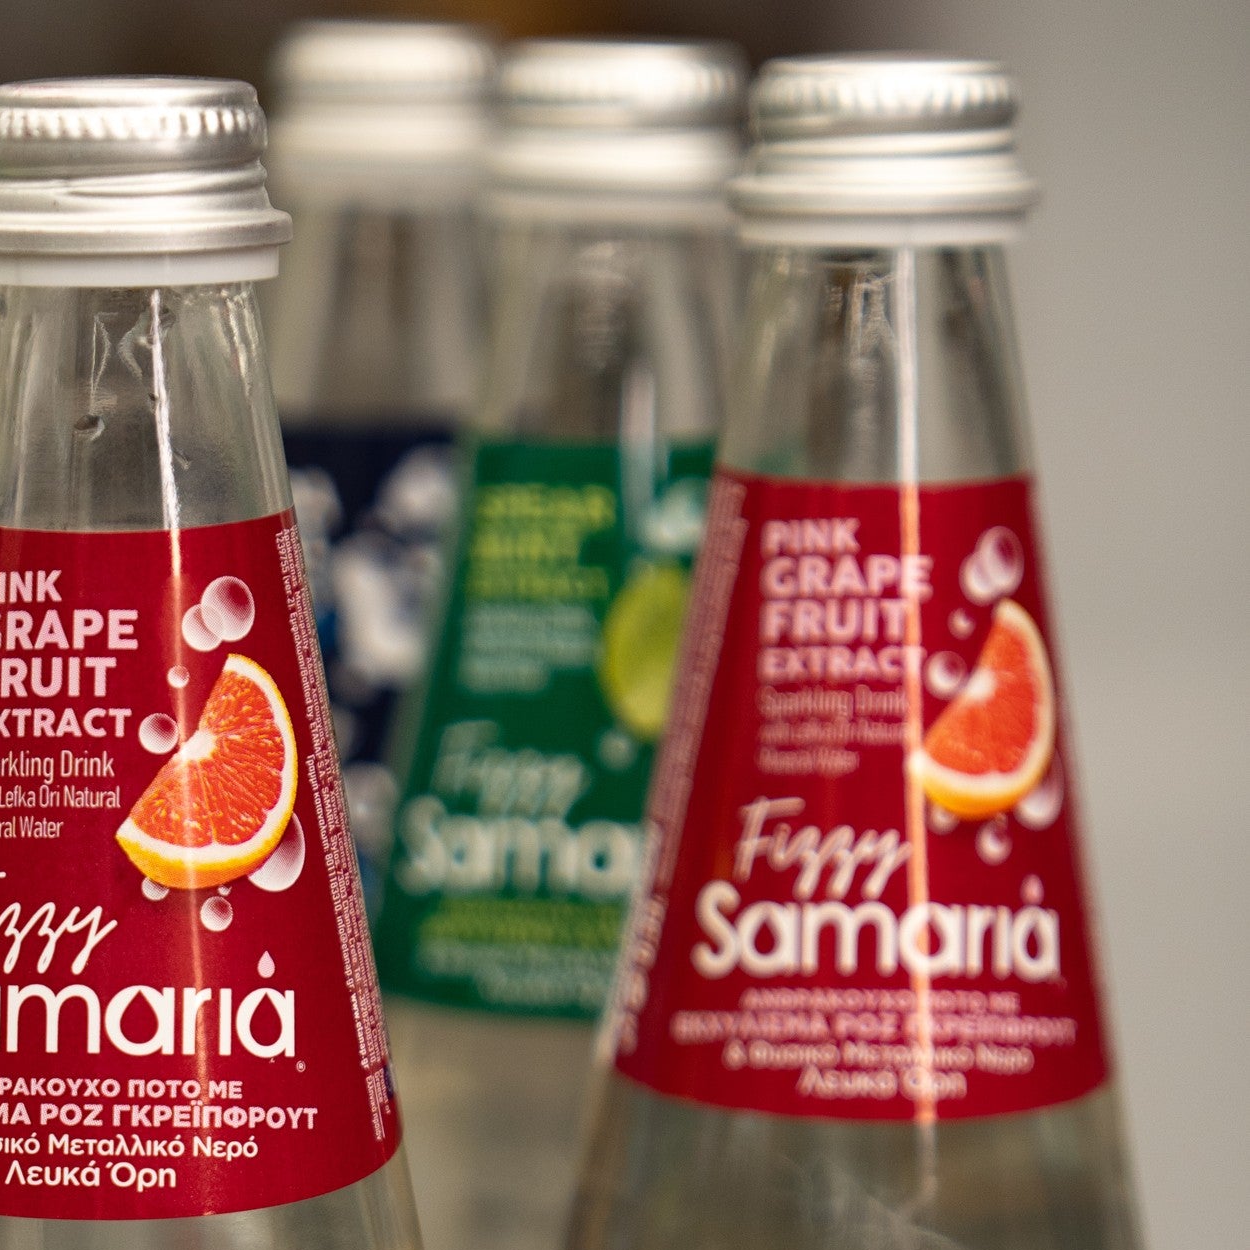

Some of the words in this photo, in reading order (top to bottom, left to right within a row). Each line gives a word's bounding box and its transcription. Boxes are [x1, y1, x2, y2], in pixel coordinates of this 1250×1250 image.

[760, 518, 859, 553] PINK
[760, 555, 933, 597] GRAPE
[759, 599, 920, 643] FRUIT
[758, 646, 926, 682] EXTRACT
[274, 530, 290, 573] 1239755
[308, 721, 322, 760] ETANAP
[335, 868, 348, 899] 73003
[60, 750, 115, 777] Drink
[39, 785, 59, 808] Ori
[62, 784, 121, 809] Natural
[18, 818, 63, 839] Water
[734, 796, 914, 899] Fizzy
[304, 753, 321, 791] Γραμμή
[348, 991, 370, 1070] www.etanap.gr
[128, 1078, 202, 1099] ΠΟΤΟ
[208, 1080, 243, 1100] ΜΕ
[373, 1070, 384, 1104] Greece
[39, 1103, 104, 1126] ΡΟΖ
[113, 1101, 318, 1130] ΓΚΡΕΪΠΦΡΟΥΤ
[48, 1133, 185, 1158] Μεταλλικό
[193, 1136, 259, 1160] Νερό
[5, 1159, 101, 1187] Λευκά
[104, 1159, 177, 1193] Όρη
